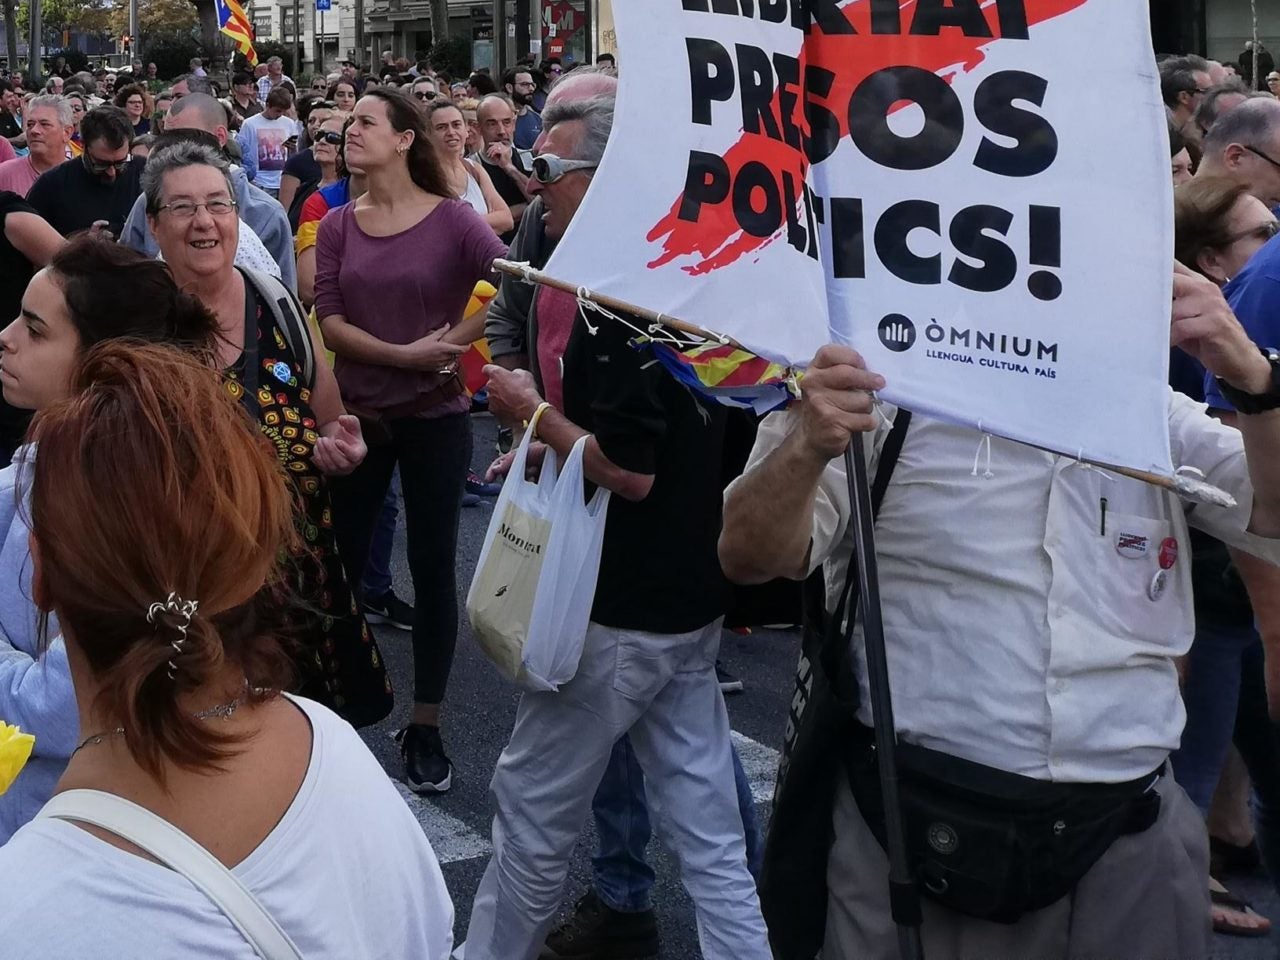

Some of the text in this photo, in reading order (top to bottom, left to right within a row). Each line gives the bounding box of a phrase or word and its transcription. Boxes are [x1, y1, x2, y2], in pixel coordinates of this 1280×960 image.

[685, 37, 1059, 178] PRESOS
[925, 318, 1058, 362] ÒMNIUM
[926, 349, 1057, 379] LLENGUA CULTURA PAÍS
